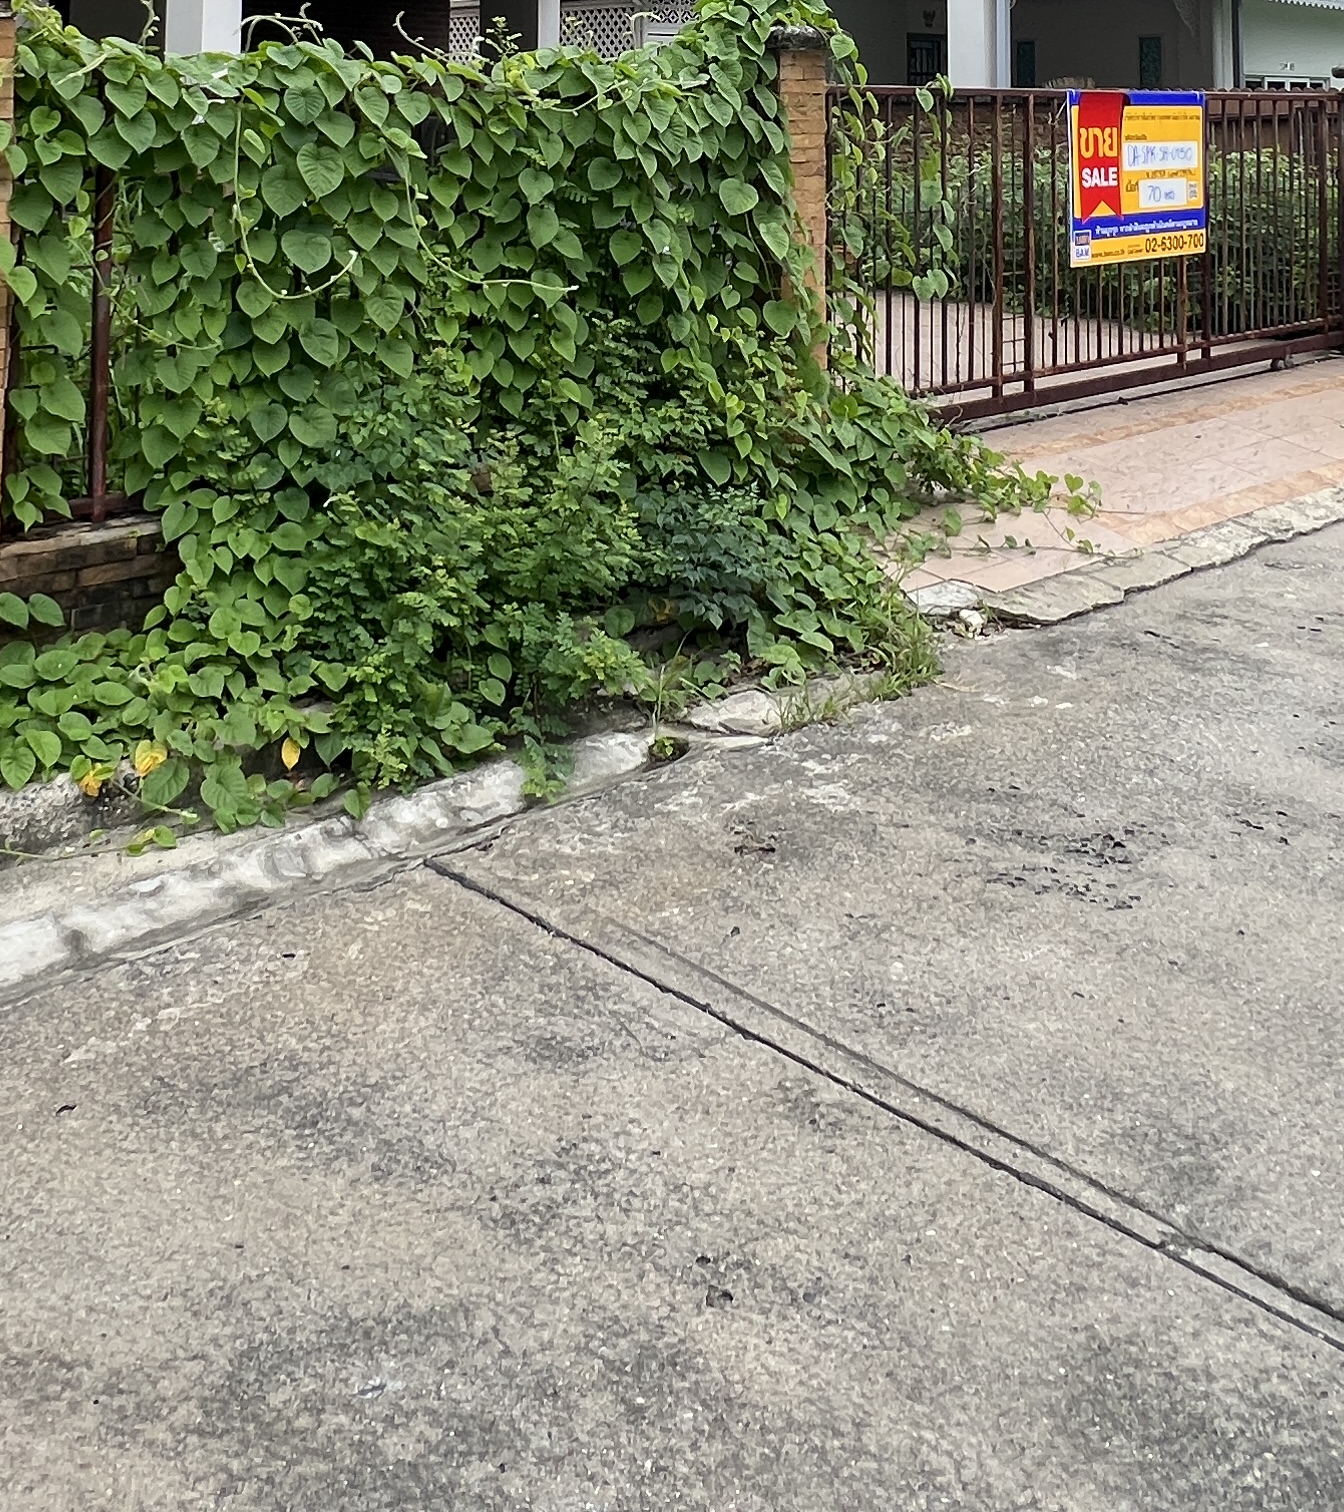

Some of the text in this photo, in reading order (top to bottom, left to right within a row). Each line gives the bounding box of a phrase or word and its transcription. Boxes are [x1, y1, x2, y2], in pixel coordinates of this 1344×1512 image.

[1080, 127, 1118, 158] ขาย
[1082, 167, 1118, 188] SALE
[1145, 232, 1204, 253] 02-6300-700
